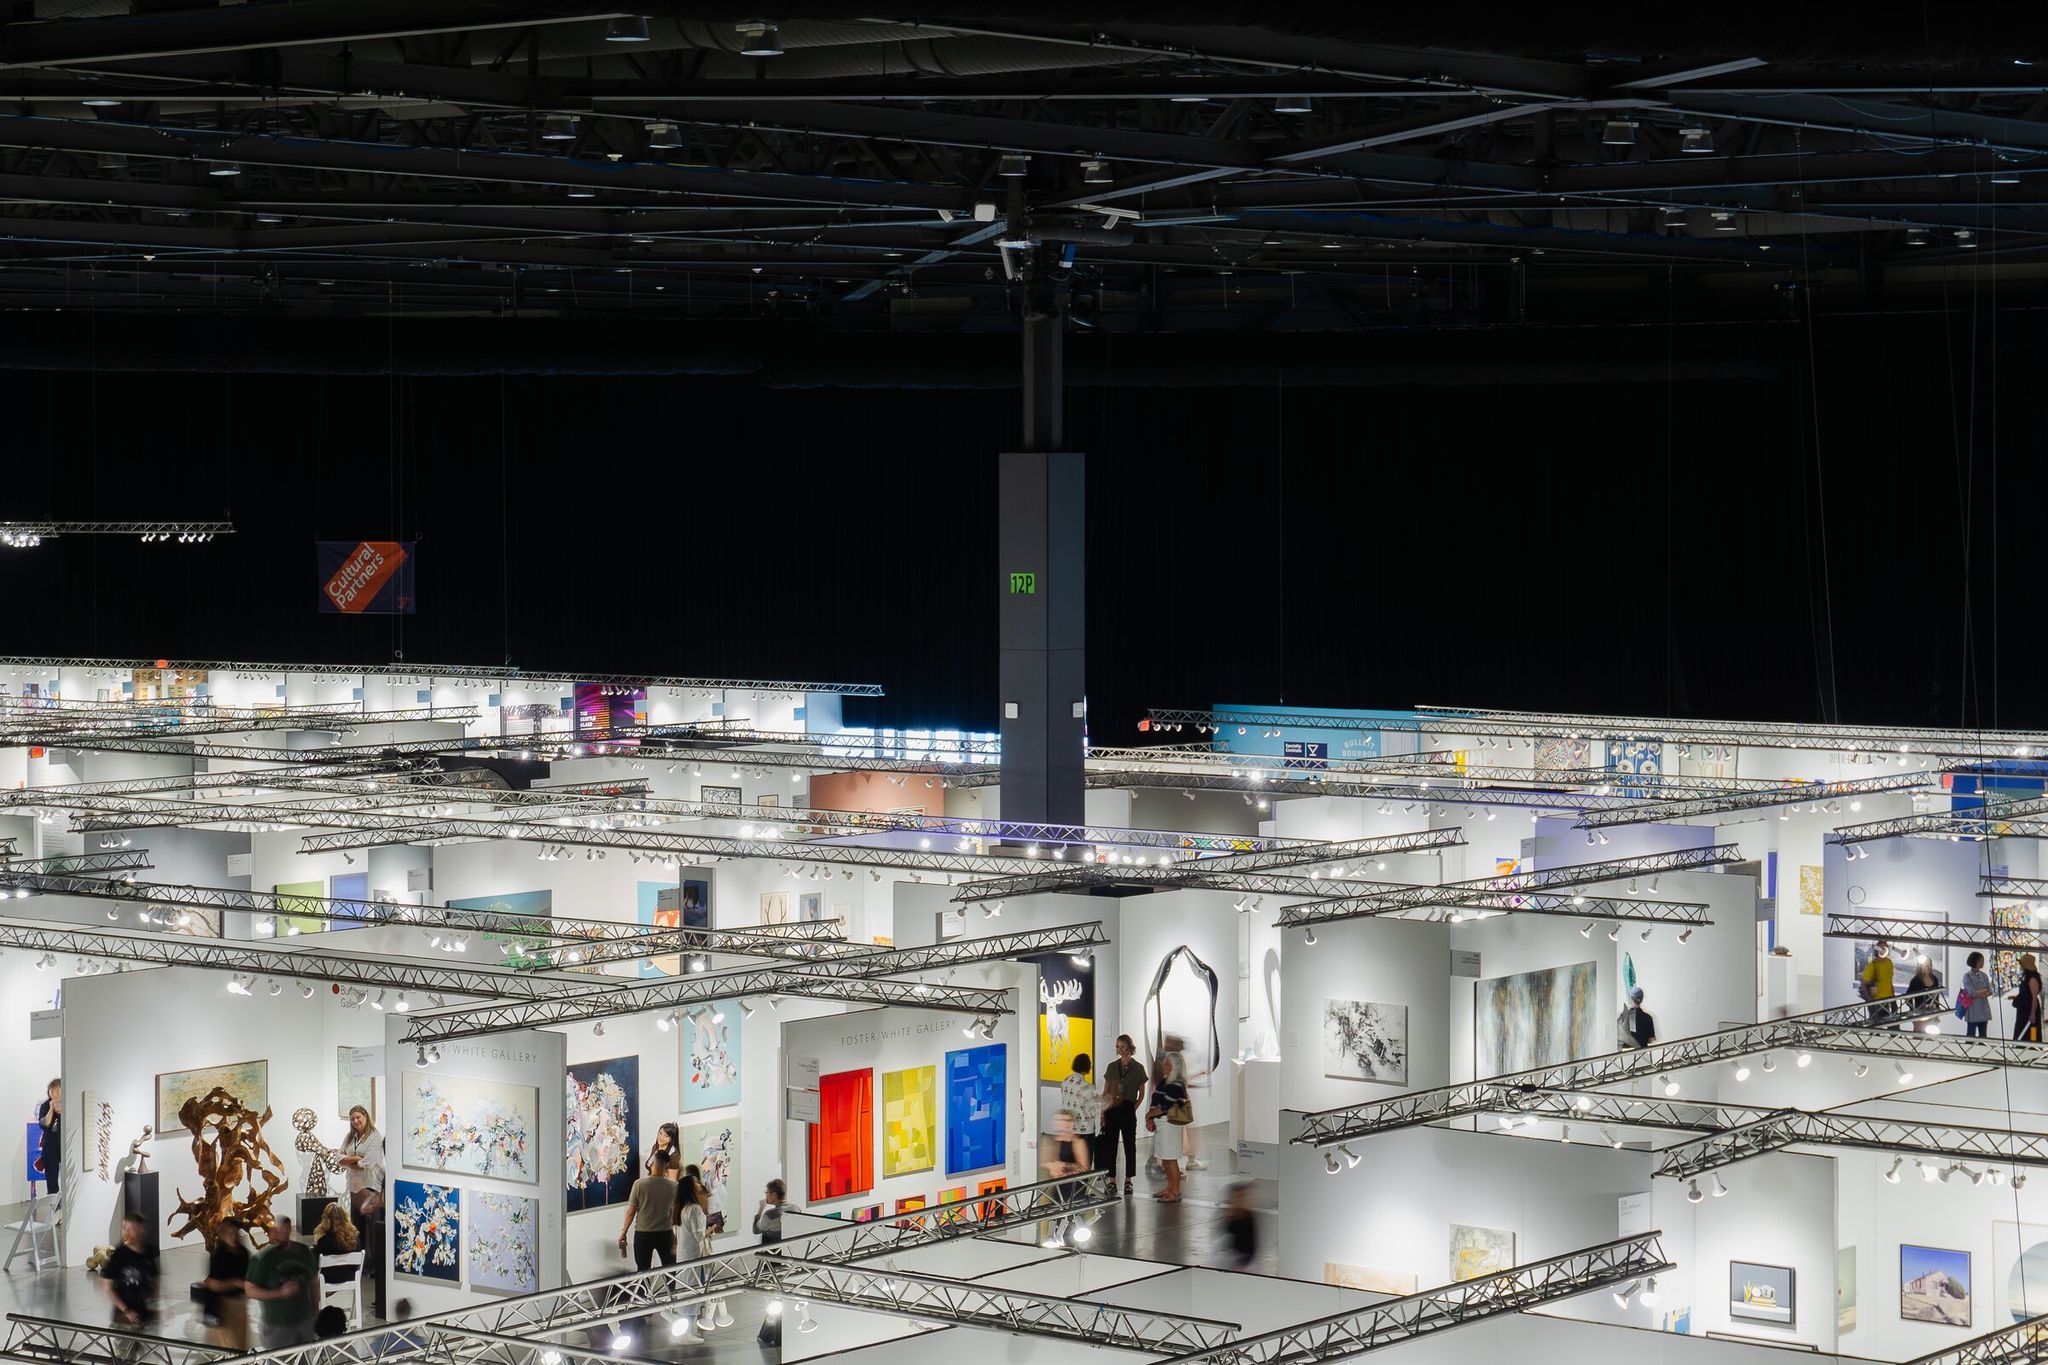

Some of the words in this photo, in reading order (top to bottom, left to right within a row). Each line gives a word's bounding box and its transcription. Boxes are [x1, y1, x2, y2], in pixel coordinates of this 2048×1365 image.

[329, 542, 374, 597] Cultural
[336, 553, 384, 609] Partners
[1012, 575, 1033, 594] 12P
[1342, 749, 1377, 758] BOURBON
[841, 1026, 911, 1046] FOSTER/WHITE
[916, 1020, 957, 1034] GALLERY
[491, 1048, 537, 1063] GALLERY
